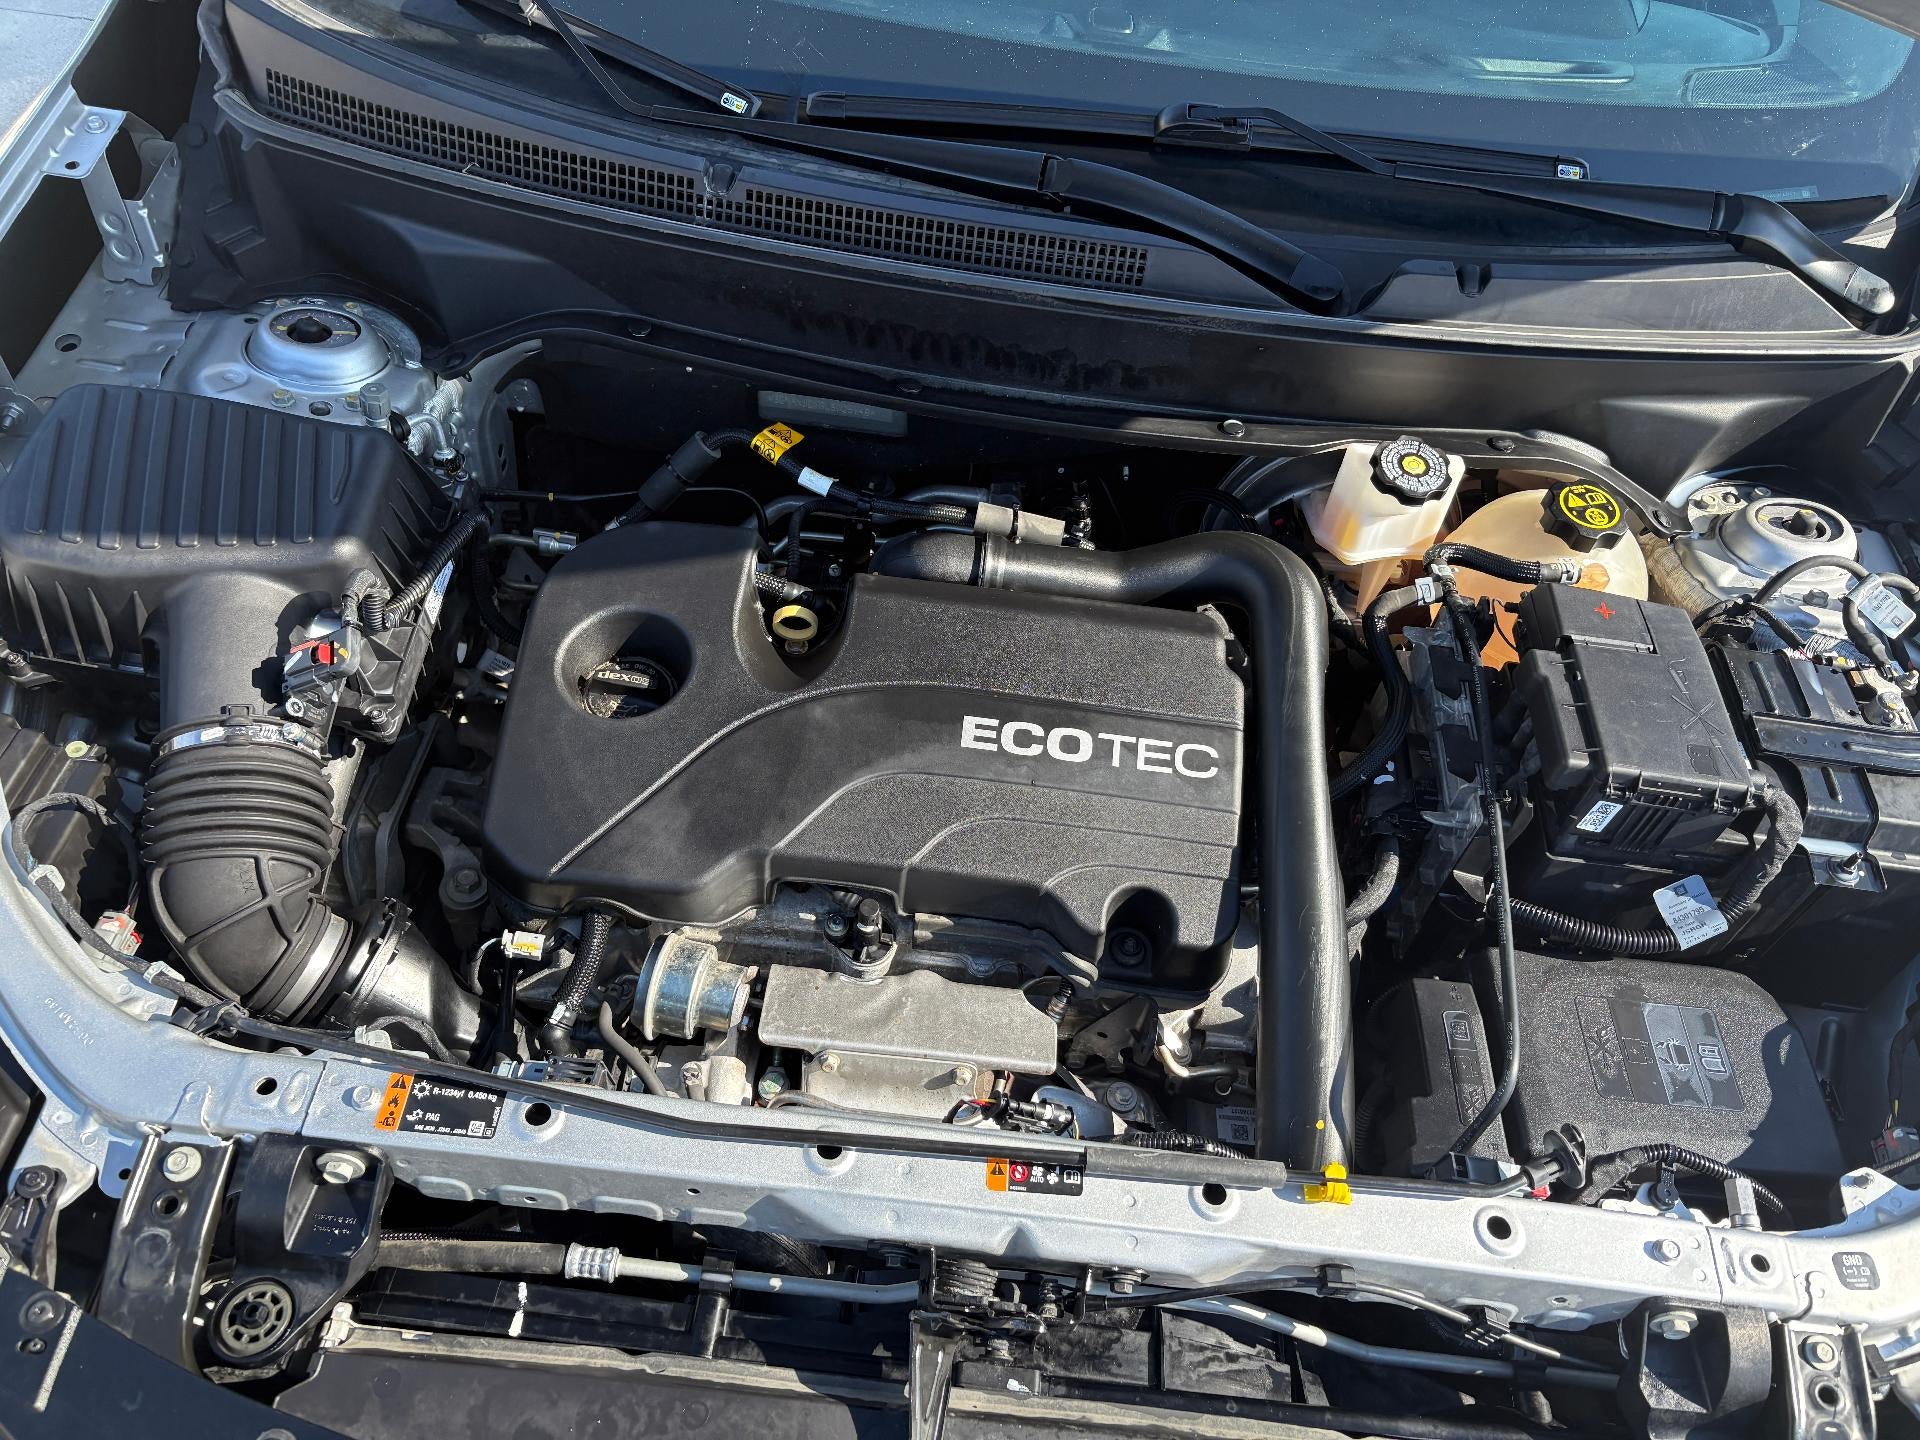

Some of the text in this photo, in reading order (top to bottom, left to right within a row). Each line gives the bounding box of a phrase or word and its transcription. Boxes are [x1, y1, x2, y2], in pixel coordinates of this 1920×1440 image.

[961, 715, 1219, 779] ECOTEC
[432, 1087, 465, 1099] R-1234yf
[425, 1112, 440, 1122] PAG
[1029, 1175, 1044, 1184] AUTO
[1842, 1254, 1863, 1267] GND
